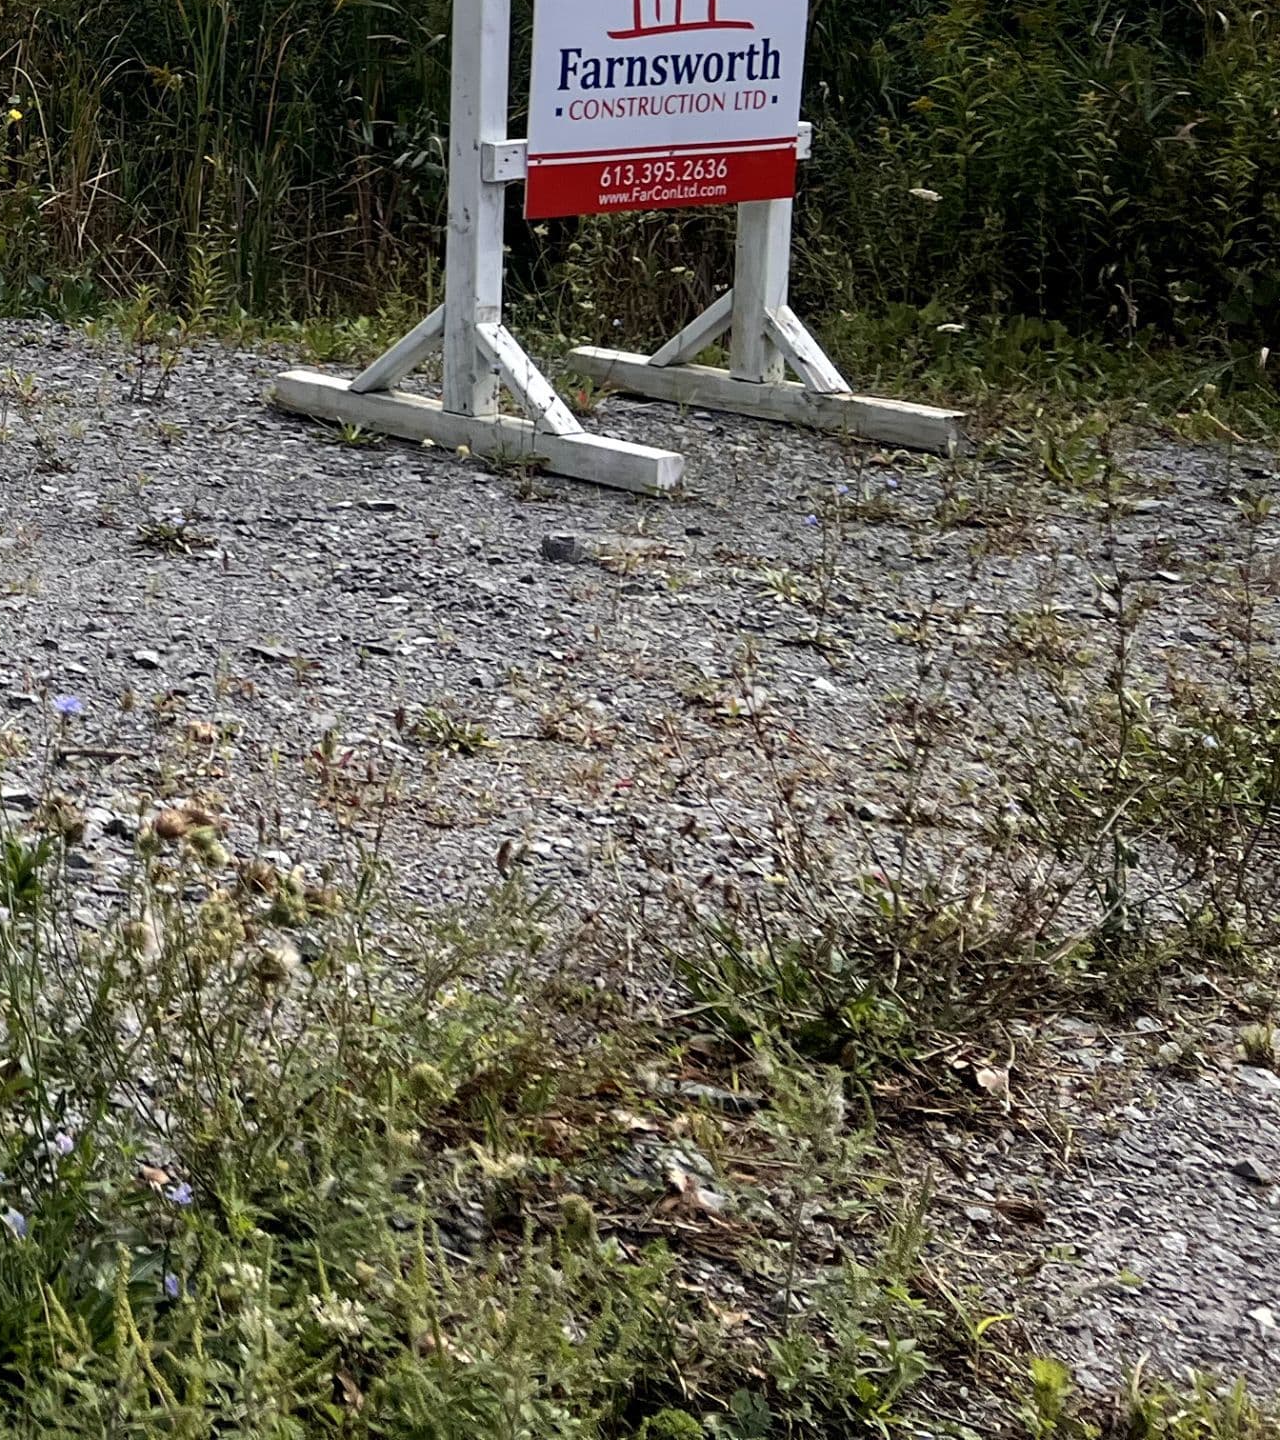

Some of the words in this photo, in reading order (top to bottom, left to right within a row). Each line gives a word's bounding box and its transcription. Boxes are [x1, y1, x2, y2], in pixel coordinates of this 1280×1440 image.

[557, 37, 781, 91] Farnsworth
[568, 93, 727, 121] CONSTRUCTION
[733, 90, 767, 112] LTD
[600, 158, 728, 188] 613.395.2636
[598, 183, 727, 205] www.FarConLtd.com
